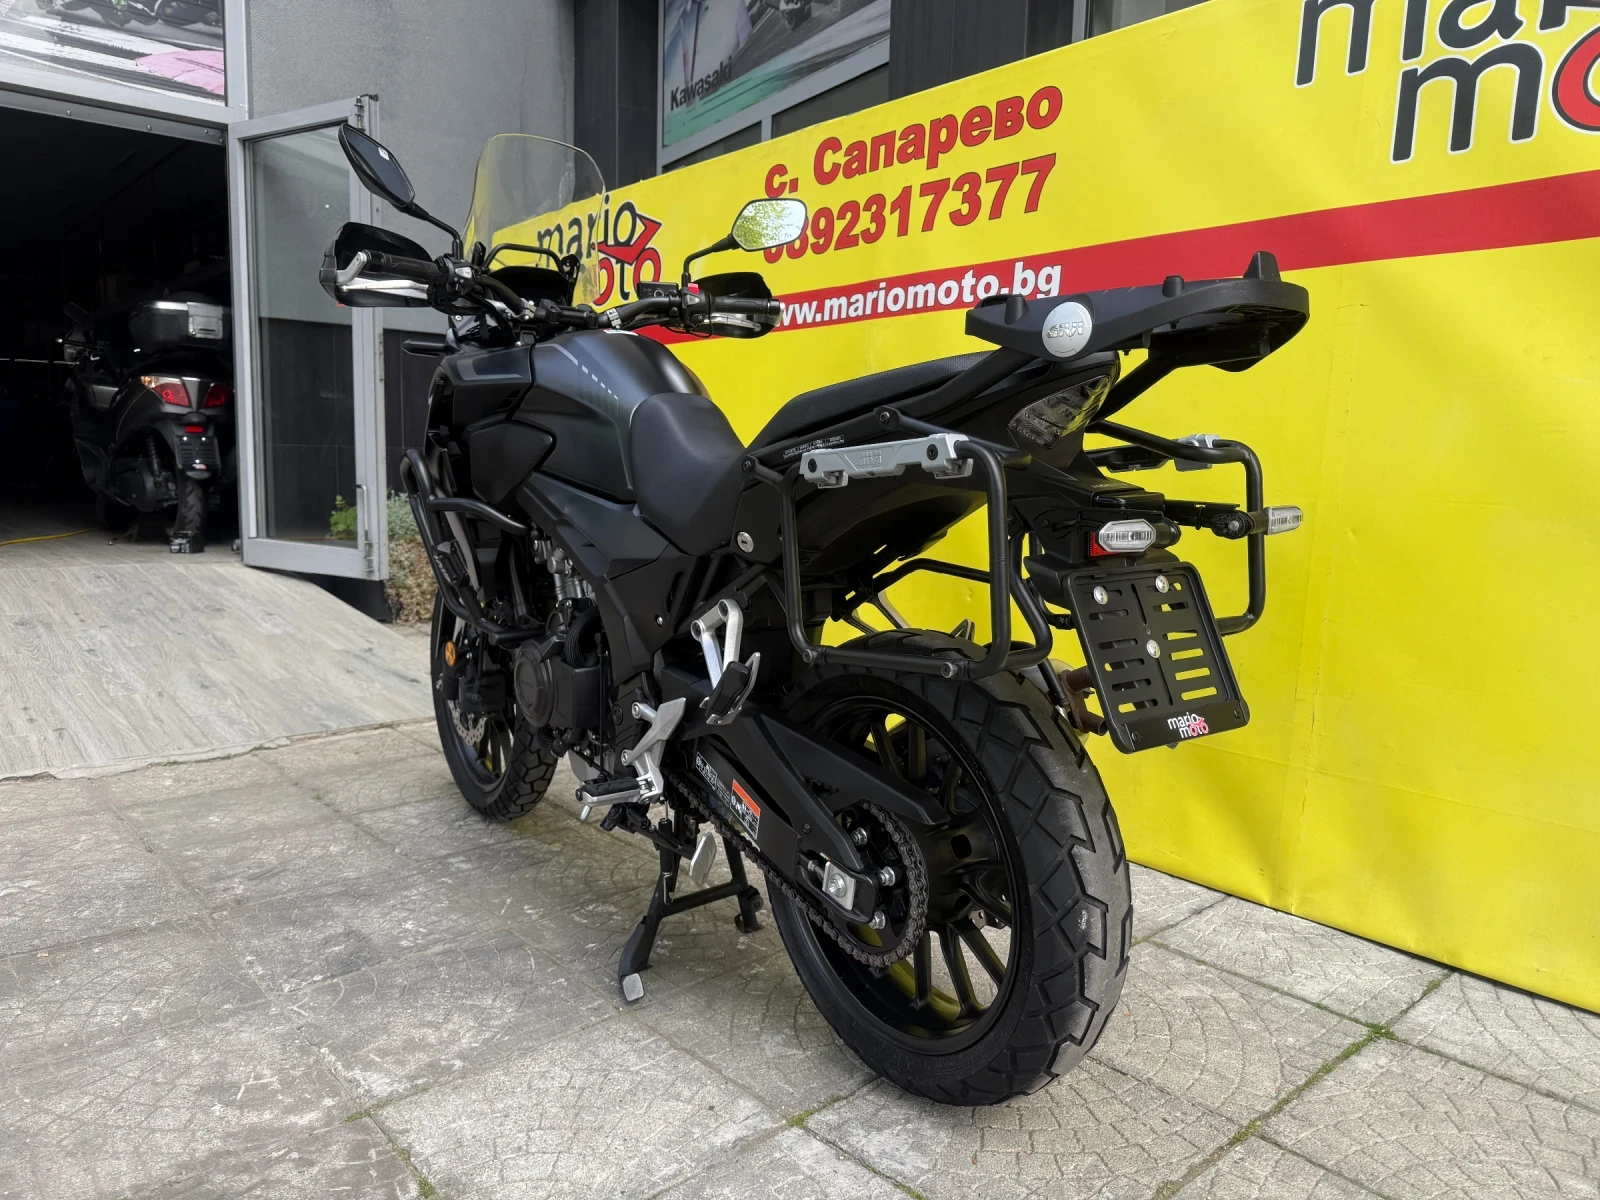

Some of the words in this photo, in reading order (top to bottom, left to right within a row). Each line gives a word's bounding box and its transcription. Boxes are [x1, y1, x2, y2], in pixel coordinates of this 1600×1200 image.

[671, 55, 733, 112] Kawasaki
[813, 85, 1063, 186] Сапарево
[763, 152, 1057, 265] 892317377
[578, 247, 662, 306] oto
[1046, 321, 1084, 339] GIVI
[1167, 711, 1199, 730] mario
[1179, 722, 1209, 739] moto
